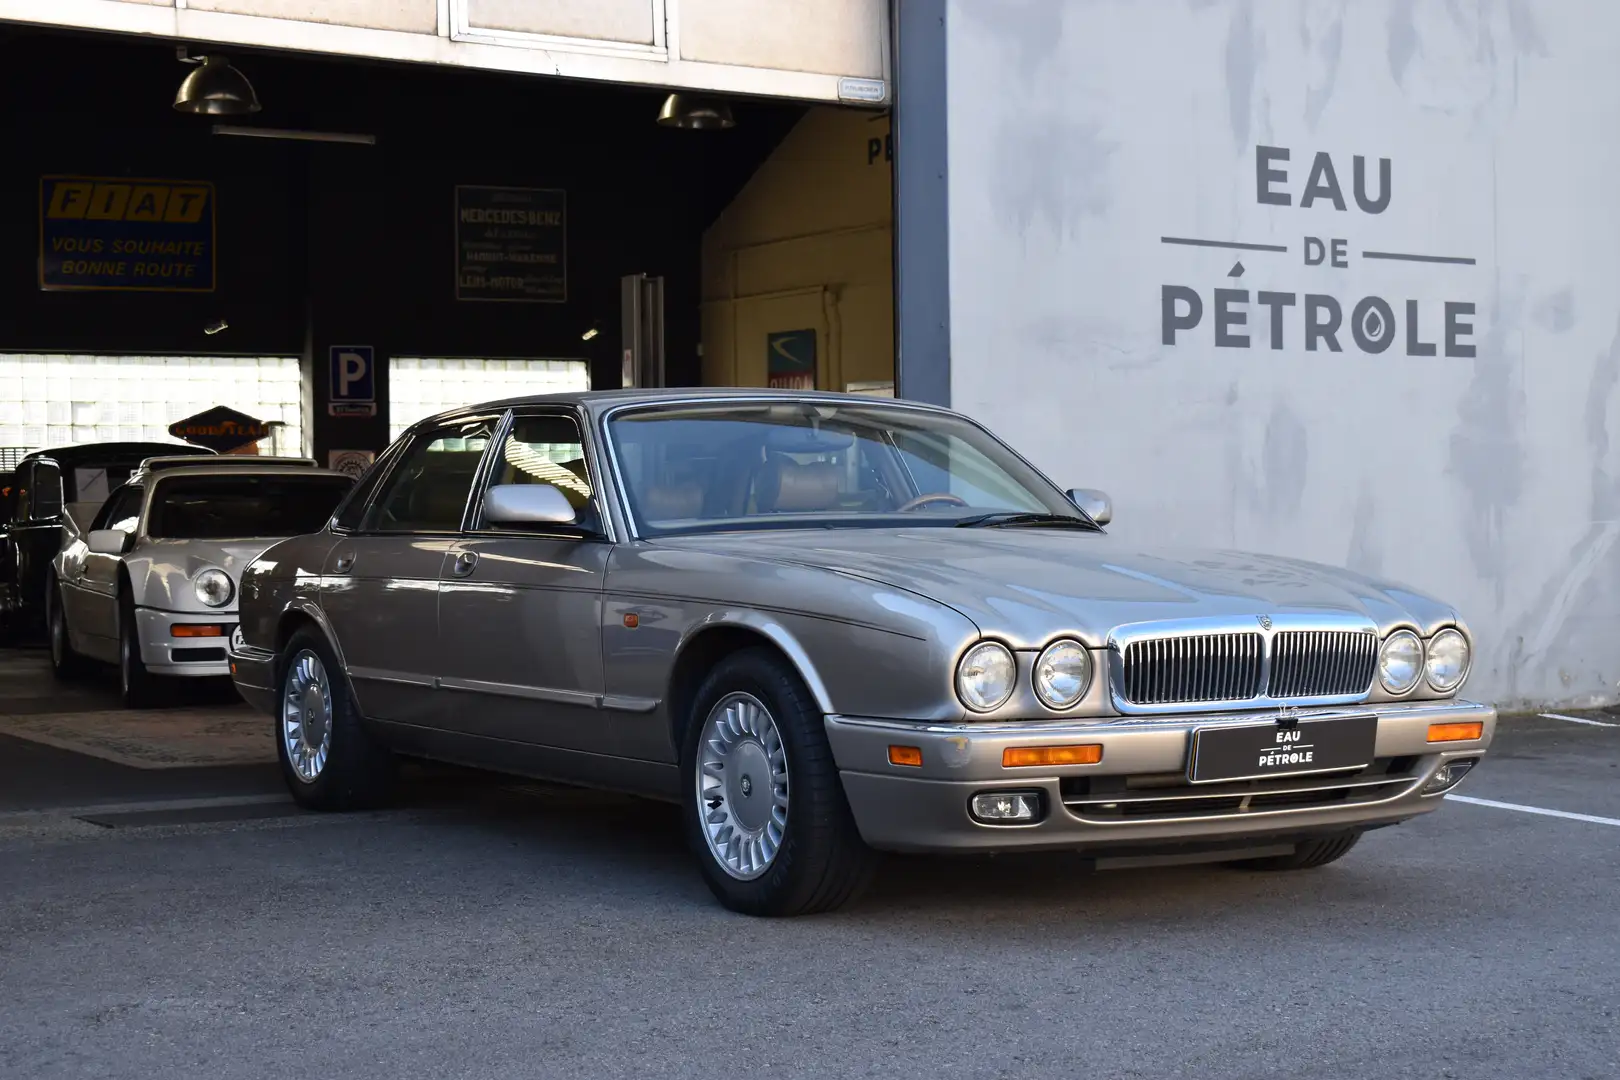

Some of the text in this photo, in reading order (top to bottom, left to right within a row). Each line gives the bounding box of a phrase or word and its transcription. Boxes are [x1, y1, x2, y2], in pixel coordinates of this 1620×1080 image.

[1256, 145, 1391, 214] EAU
[58, 187, 203, 218] FIAT
[461, 208, 561, 226] MERCEDES BENZ
[53, 237, 205, 256] VOUS SOUHAITE
[1304, 237, 1348, 268] DE
[62, 260, 196, 278] BONNE ROUTE
[1162, 261, 1476, 357] PÉTROLE
[340, 353, 366, 396] P
[1276, 731, 1301, 743] EAU
[1259, 751, 1313, 766] PÉTROLE
